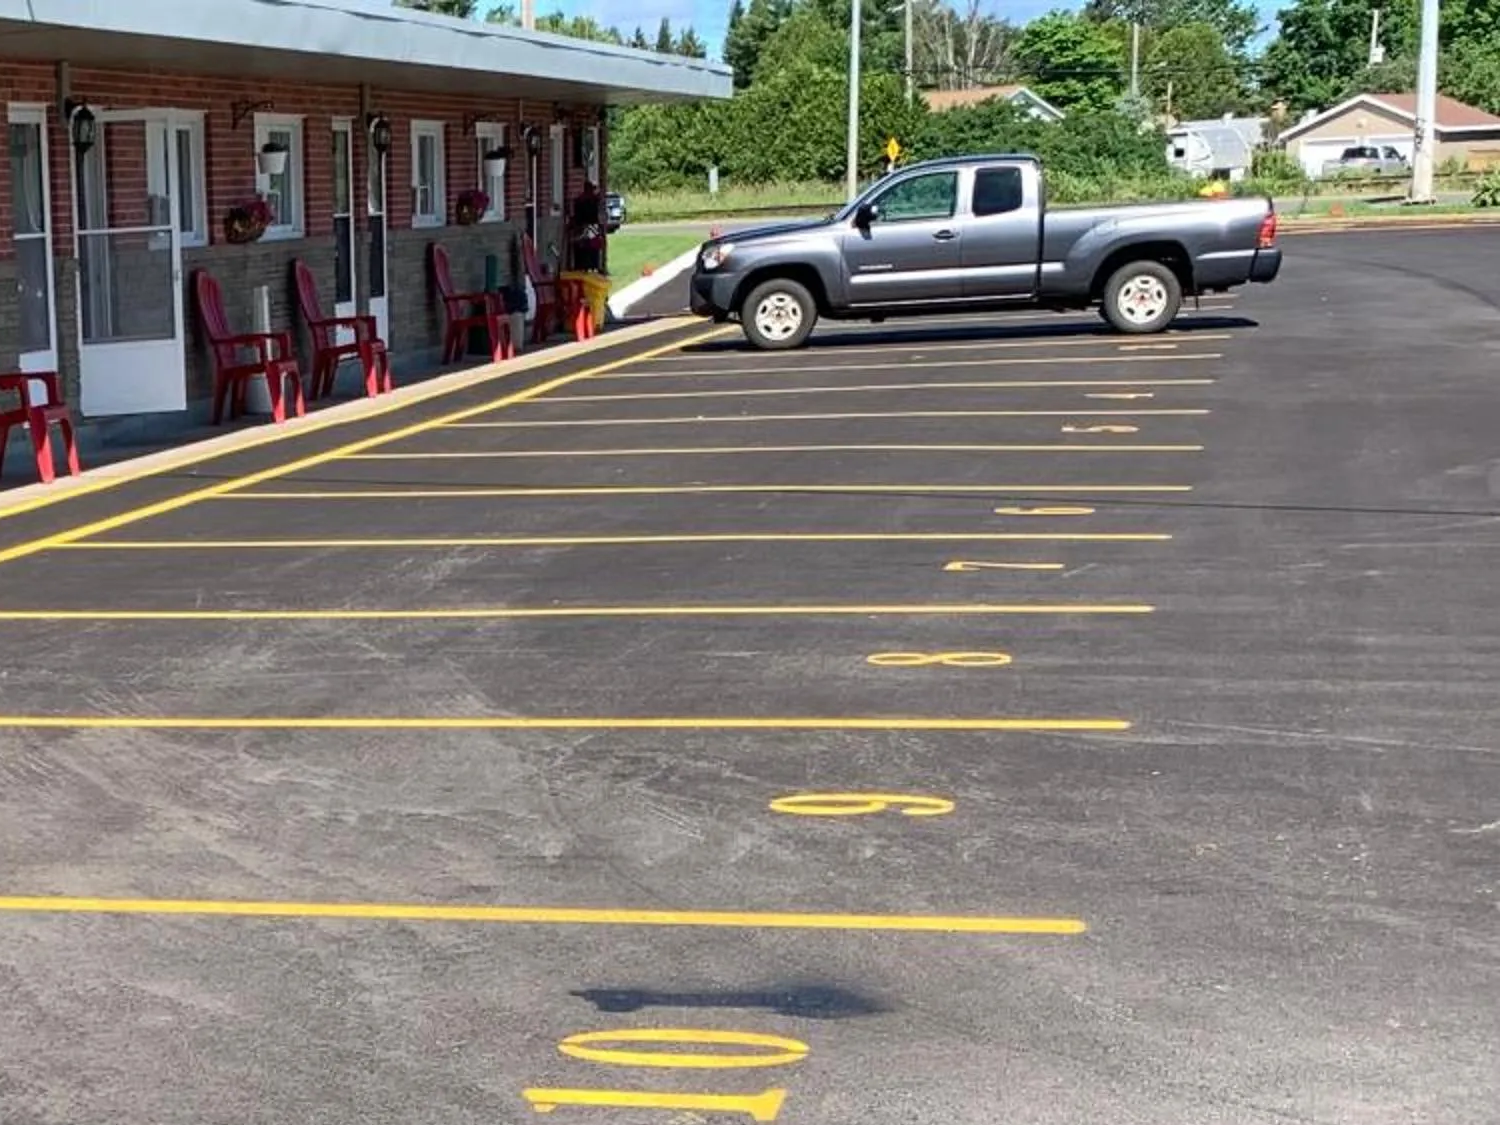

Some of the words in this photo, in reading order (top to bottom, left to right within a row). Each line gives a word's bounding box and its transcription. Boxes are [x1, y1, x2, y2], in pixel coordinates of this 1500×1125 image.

[942, 561, 1065, 571] 7
[866, 651, 1012, 667] 8
[768, 793, 956, 816] 9
[520, 1028, 811, 1121] 10
